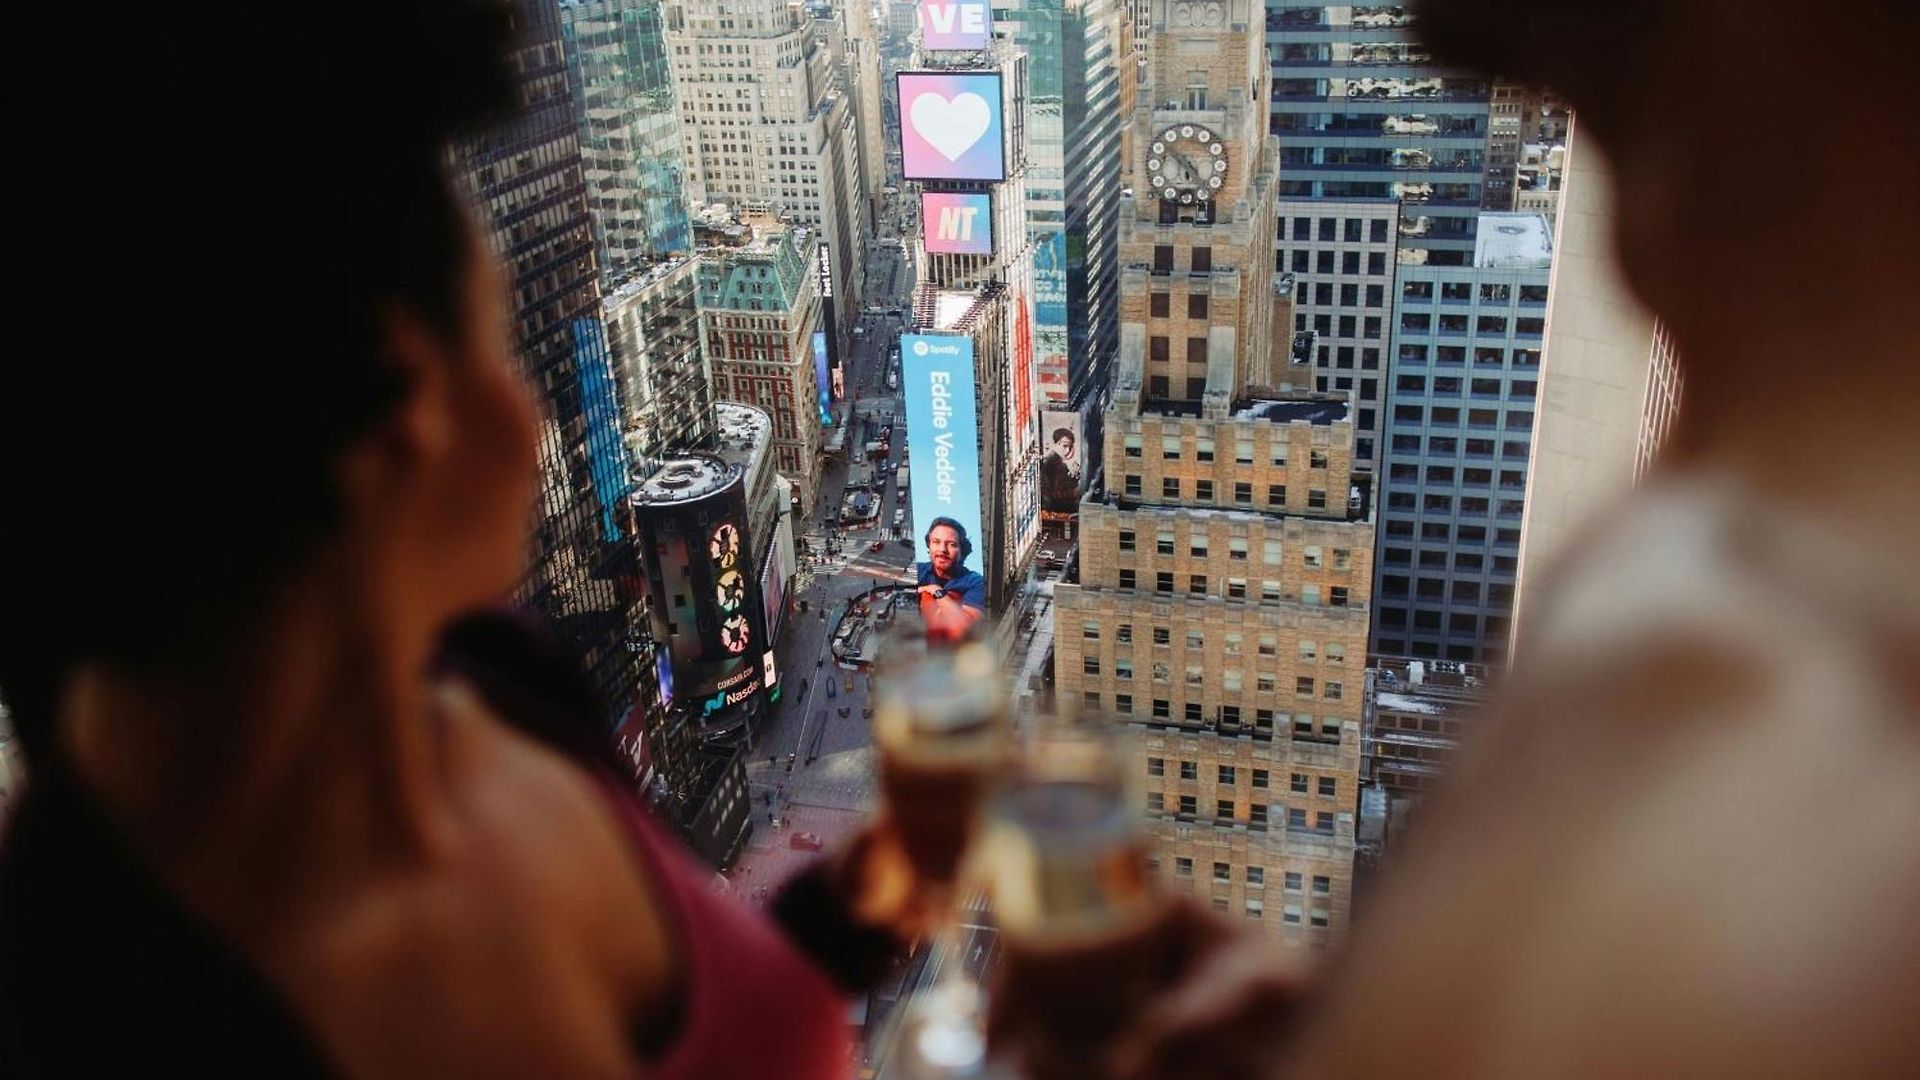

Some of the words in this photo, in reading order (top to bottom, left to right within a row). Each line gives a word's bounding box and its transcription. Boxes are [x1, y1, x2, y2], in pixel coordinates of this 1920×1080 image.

[928, 4, 984, 34] VE
[938, 207, 978, 241] NT
[930, 344, 959, 356] Spotify
[930, 371, 953, 429] Eddie
[935, 433, 957, 504] Vedder
